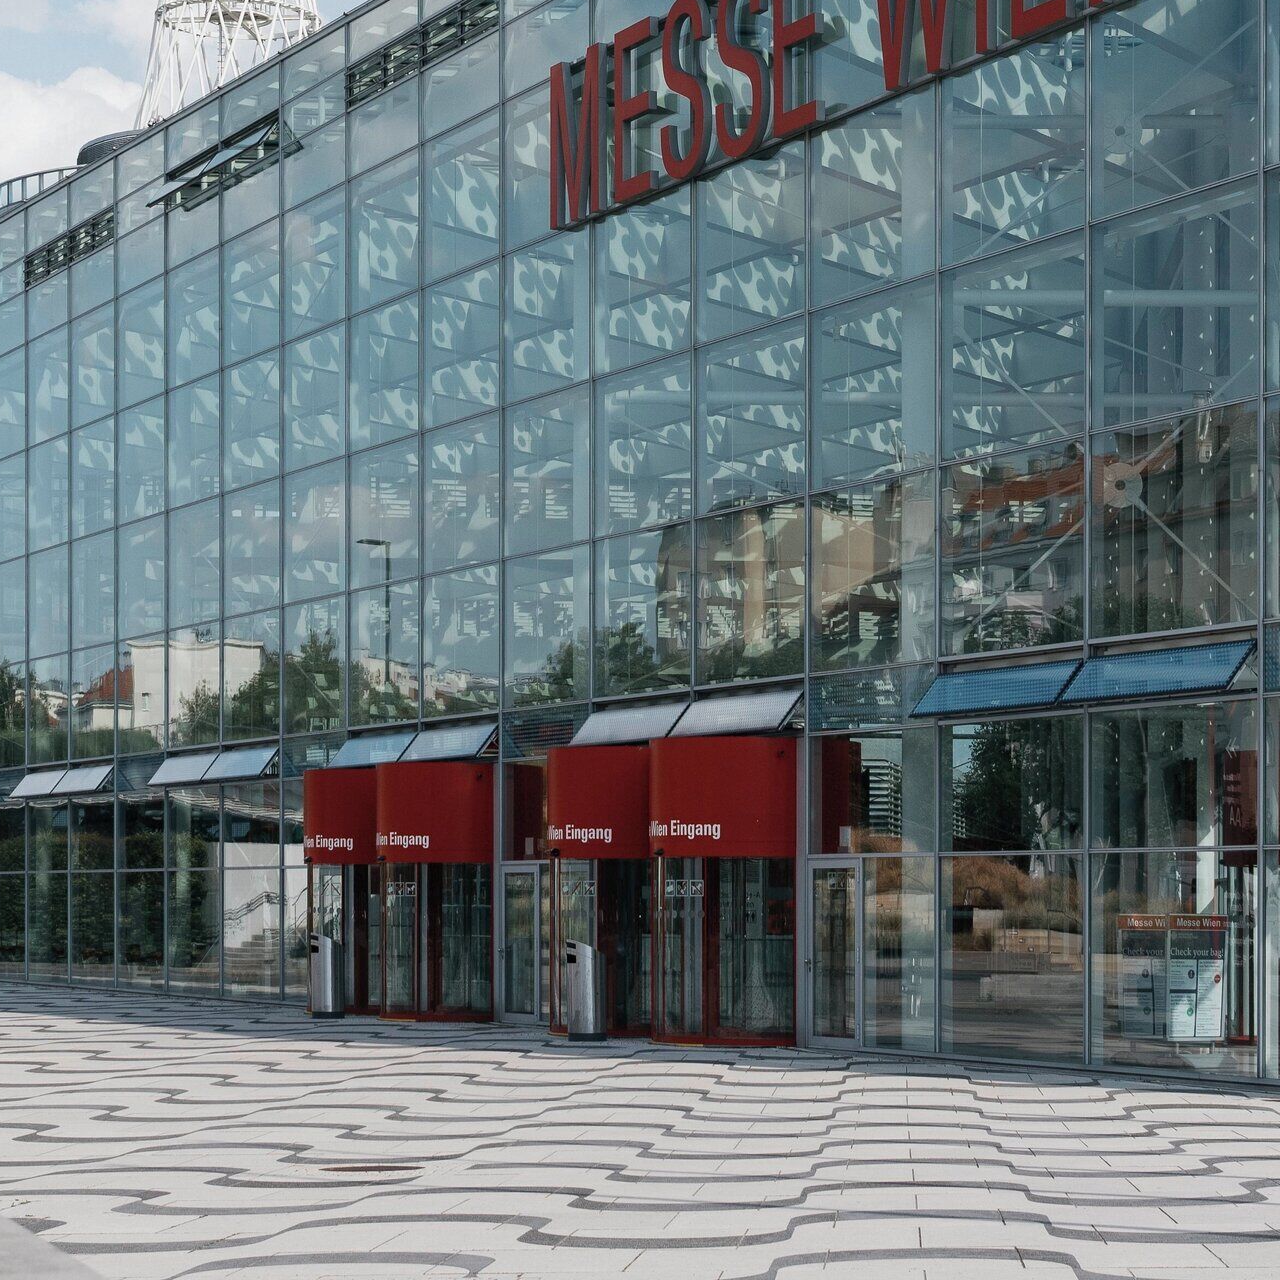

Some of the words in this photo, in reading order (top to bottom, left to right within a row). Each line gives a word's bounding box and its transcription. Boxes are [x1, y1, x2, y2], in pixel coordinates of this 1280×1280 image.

[565, 824, 613, 844] Eingang
[651, 820, 668, 837] Wien
[670, 819, 721, 840] Eingang
[315, 834, 354, 851] Eingang
[389, 831, 430, 849] Eingang
[1127, 918, 1153, 927] Messe
[1176, 918, 1200, 927] Messe
[1202, 918, 1221, 927] Wien
[1170, 947, 1191, 956] Check
[1193, 949, 1209, 958] your
[1210, 947, 1224, 958] bag!
